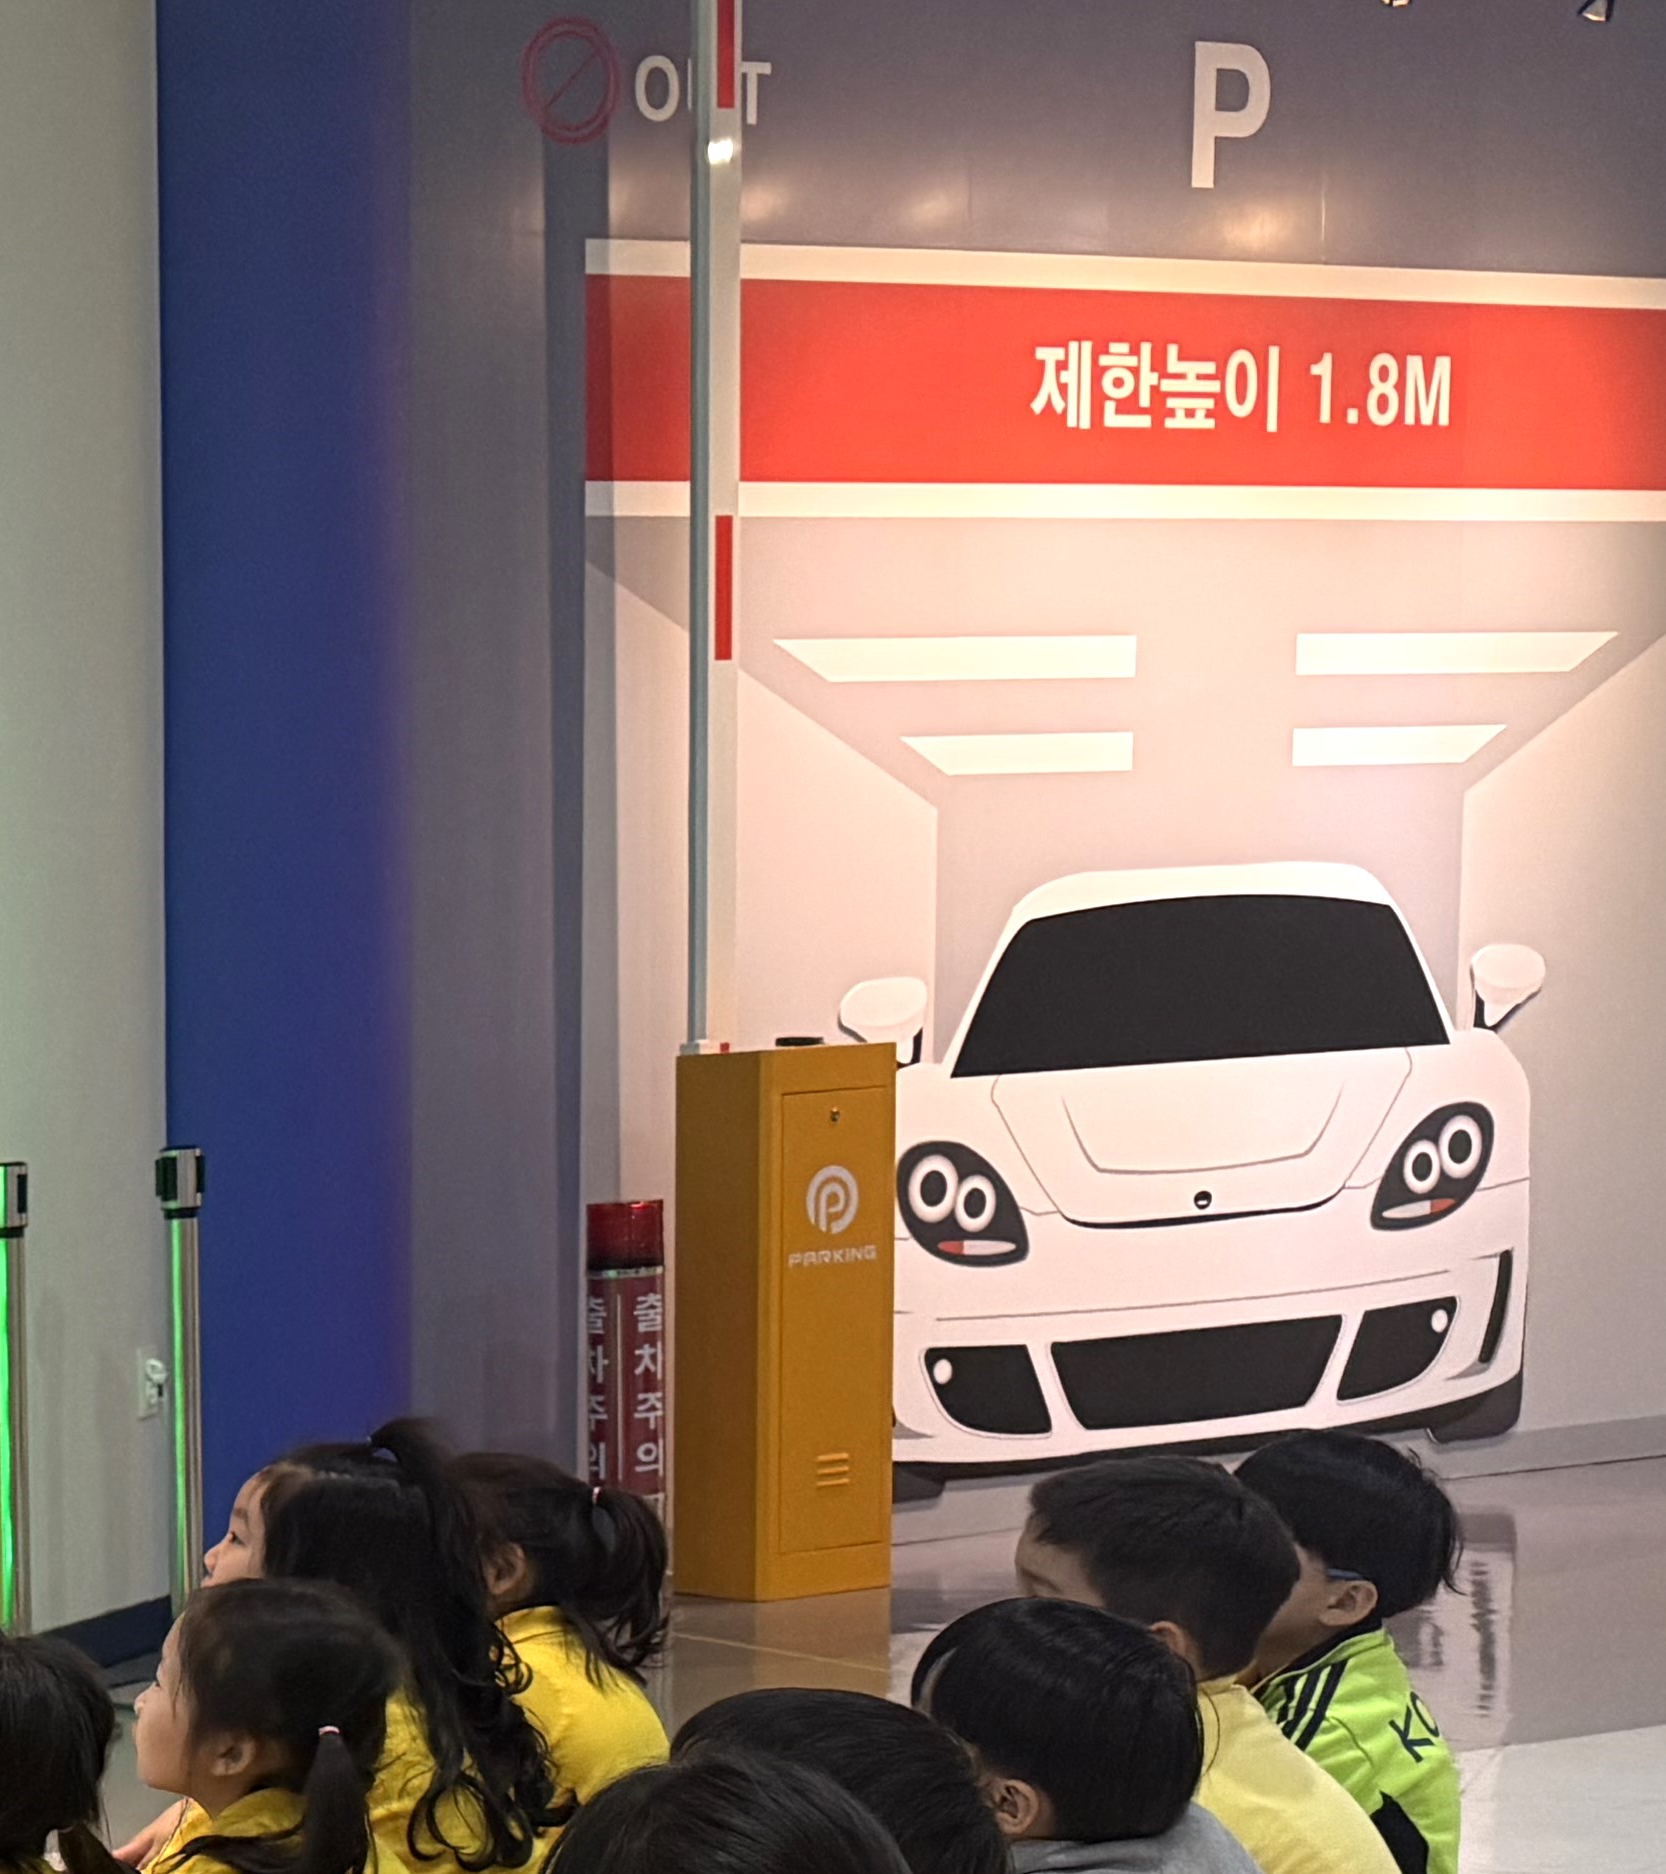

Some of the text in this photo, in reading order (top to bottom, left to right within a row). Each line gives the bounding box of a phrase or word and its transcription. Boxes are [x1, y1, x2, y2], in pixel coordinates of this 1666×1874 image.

[635, 54, 772, 125] OT
[1191, 41, 1271, 188] P
[1030, 341, 1451, 432] 제한높이 1.8M
[789, 1245, 877, 1267] PARKING
[634, 1293, 664, 1478] 출차주의
